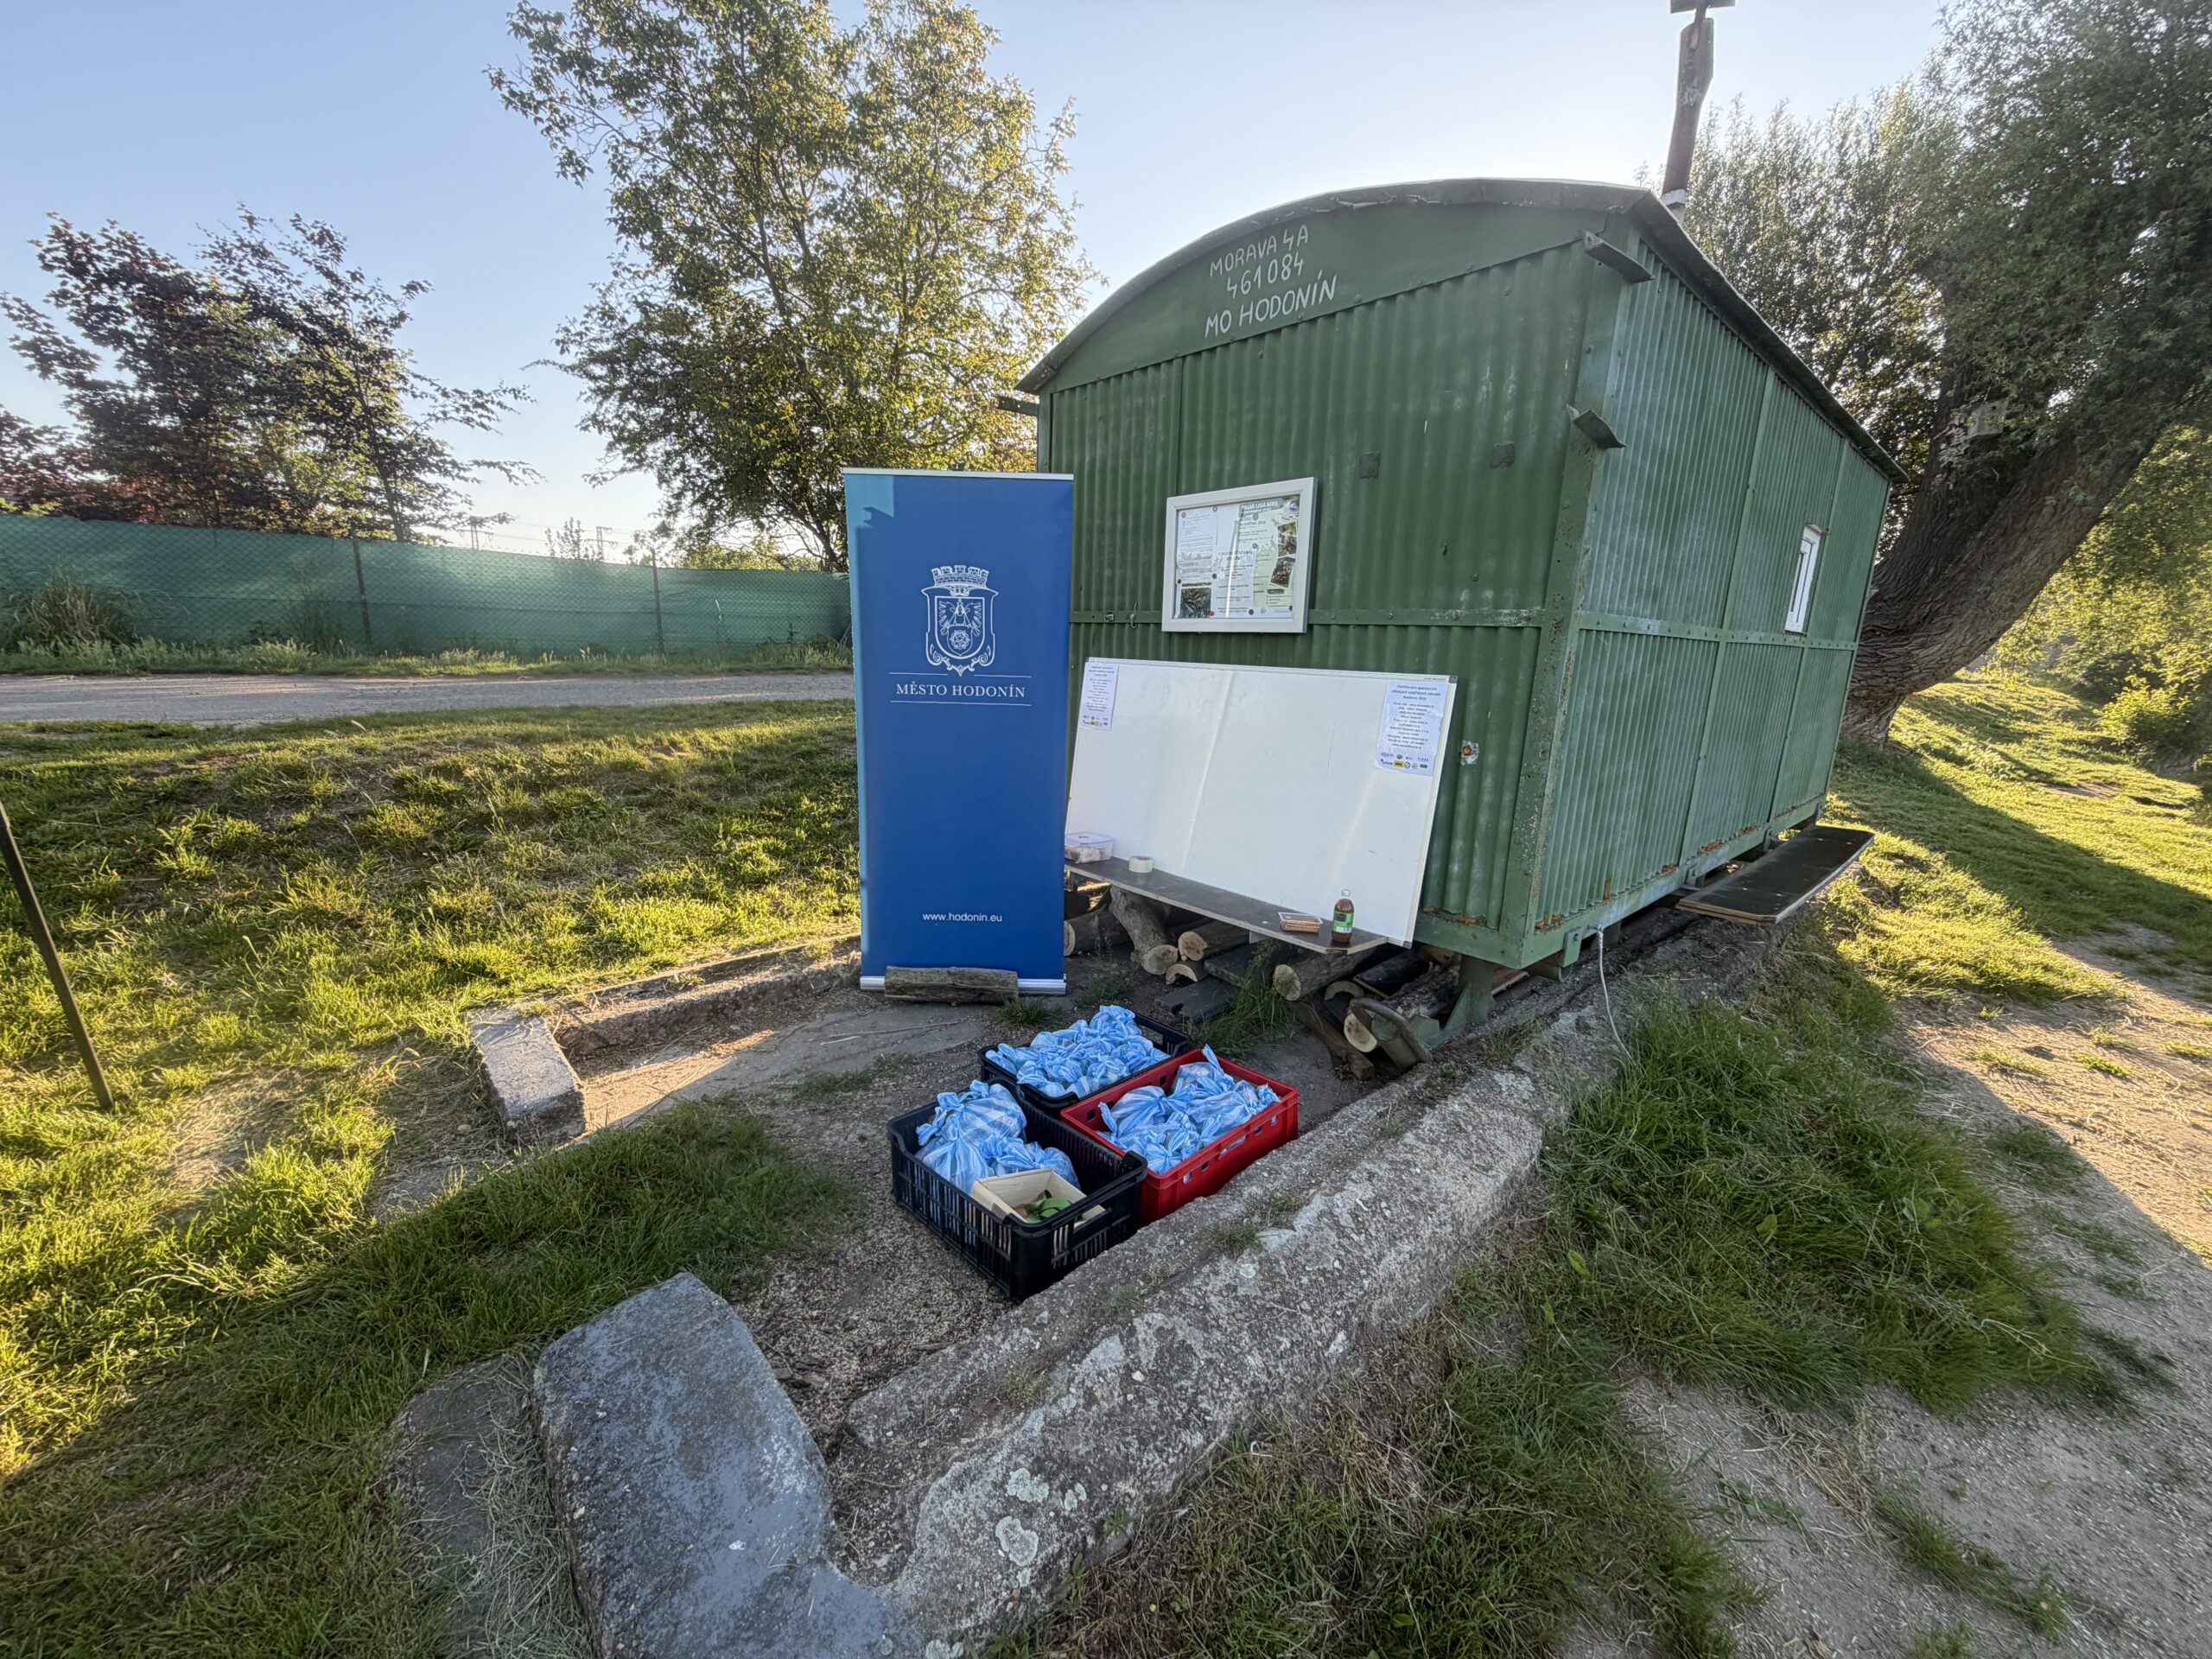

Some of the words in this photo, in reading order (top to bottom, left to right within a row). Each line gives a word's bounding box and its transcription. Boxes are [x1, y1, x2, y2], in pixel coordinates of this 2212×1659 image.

[1210, 235, 1277, 279] MORAVA
[1282, 224, 1308, 251] 4A
[1226, 251, 1304, 299] 461084
[1205, 309, 1232, 338] MO
[1238, 270, 1337, 327] HODONÍN
[896, 681, 948, 696] MĚSTO
[952, 683, 1026, 698] HODONÍN
[922, 912, 1002, 923] www.hodonin.eu
